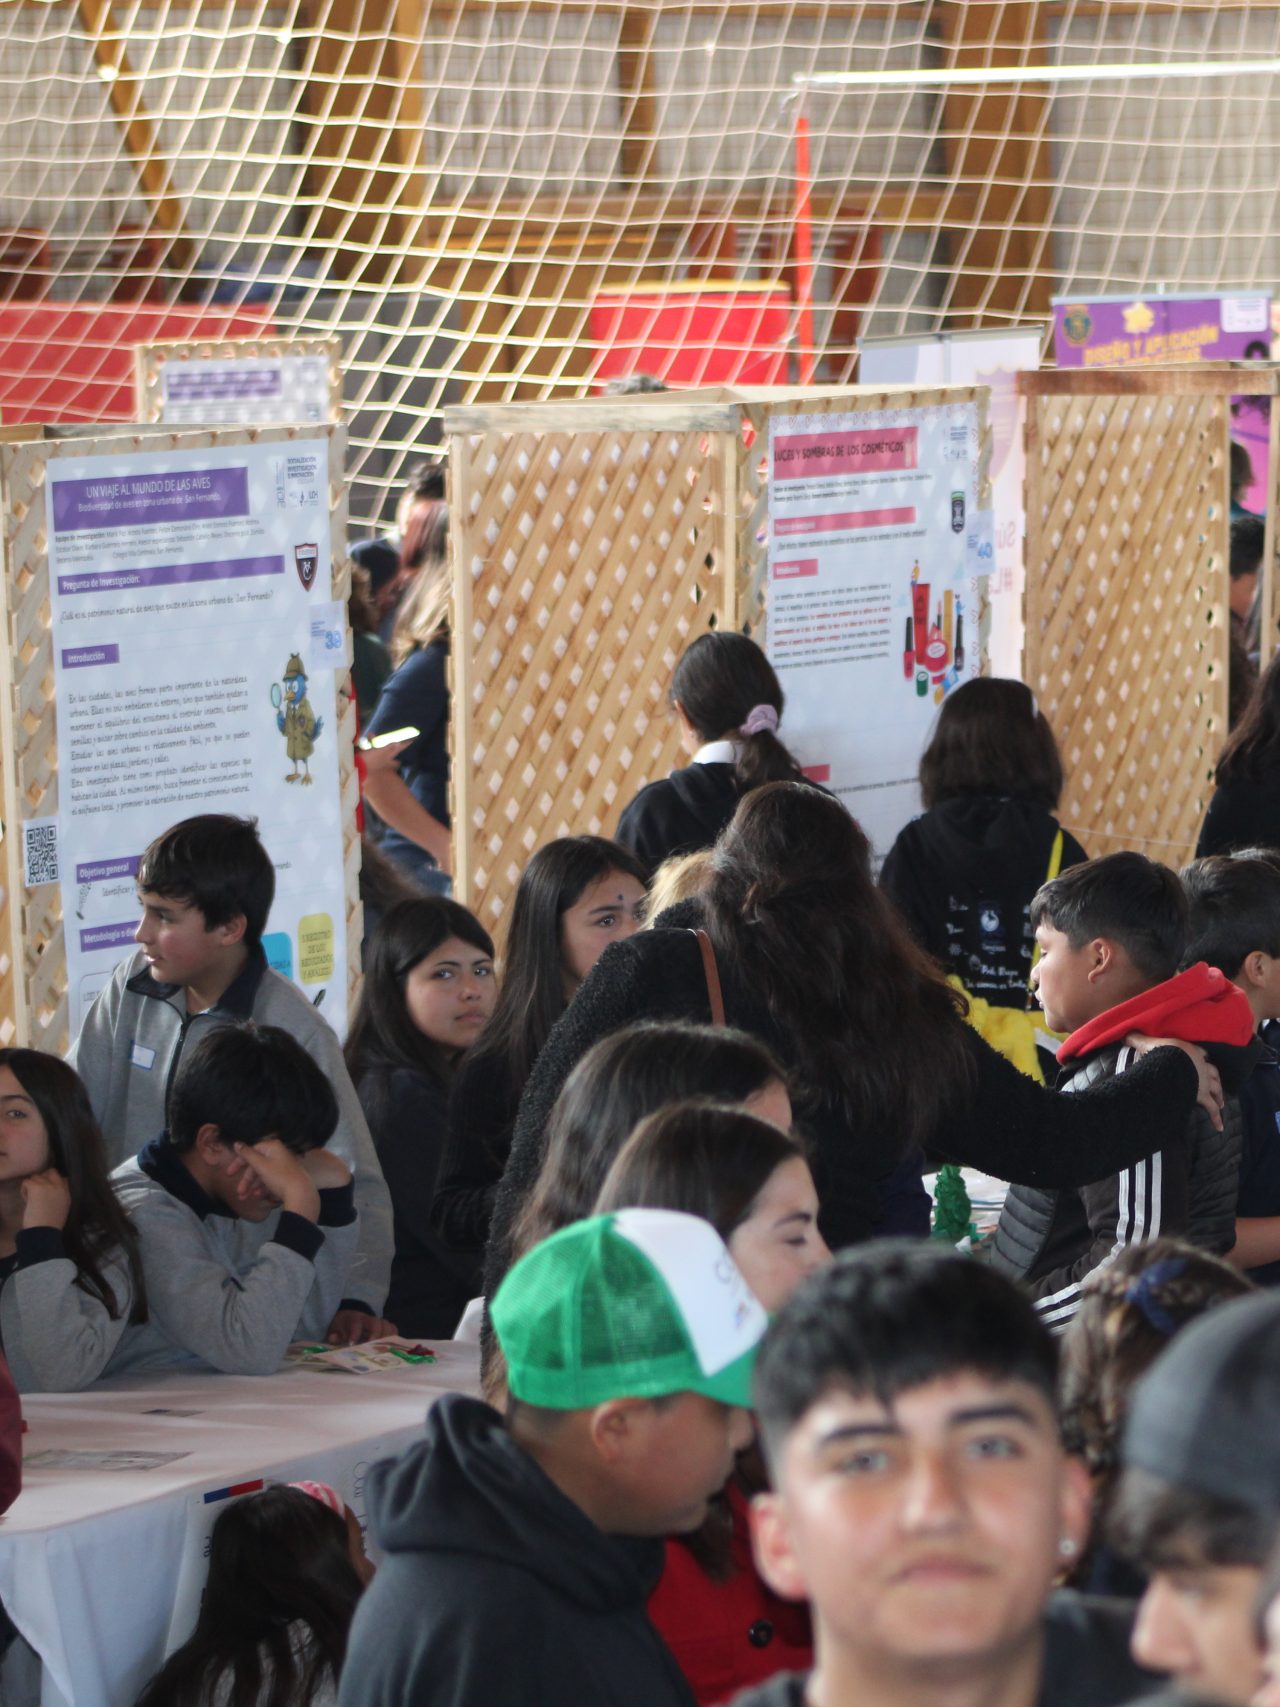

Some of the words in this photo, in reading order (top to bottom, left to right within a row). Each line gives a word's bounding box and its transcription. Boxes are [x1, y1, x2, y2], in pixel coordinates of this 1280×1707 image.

[774, 450, 794, 463] LUCES
[802, 445, 834, 460] SOMBRAS
[836, 445, 845, 457] DE
[848, 443, 860, 456] LOS
[861, 440, 904, 456] COSMÉTICOS
[87, 486, 99, 499] UN
[99, 483, 119, 499] VIAJE
[120, 482, 130, 496] AL
[132, 479, 164, 495] MUNDO
[165, 478, 176, 492] DE
[177, 477, 191, 492] LAS
[192, 475, 211, 489] AVES
[78, 500, 114, 513] Biodiversidad
[63, 579, 90, 592] Pregunta
[91, 578, 99, 588] de
[79, 868, 106, 880] Objetivo
[106, 863, 129, 876] general
